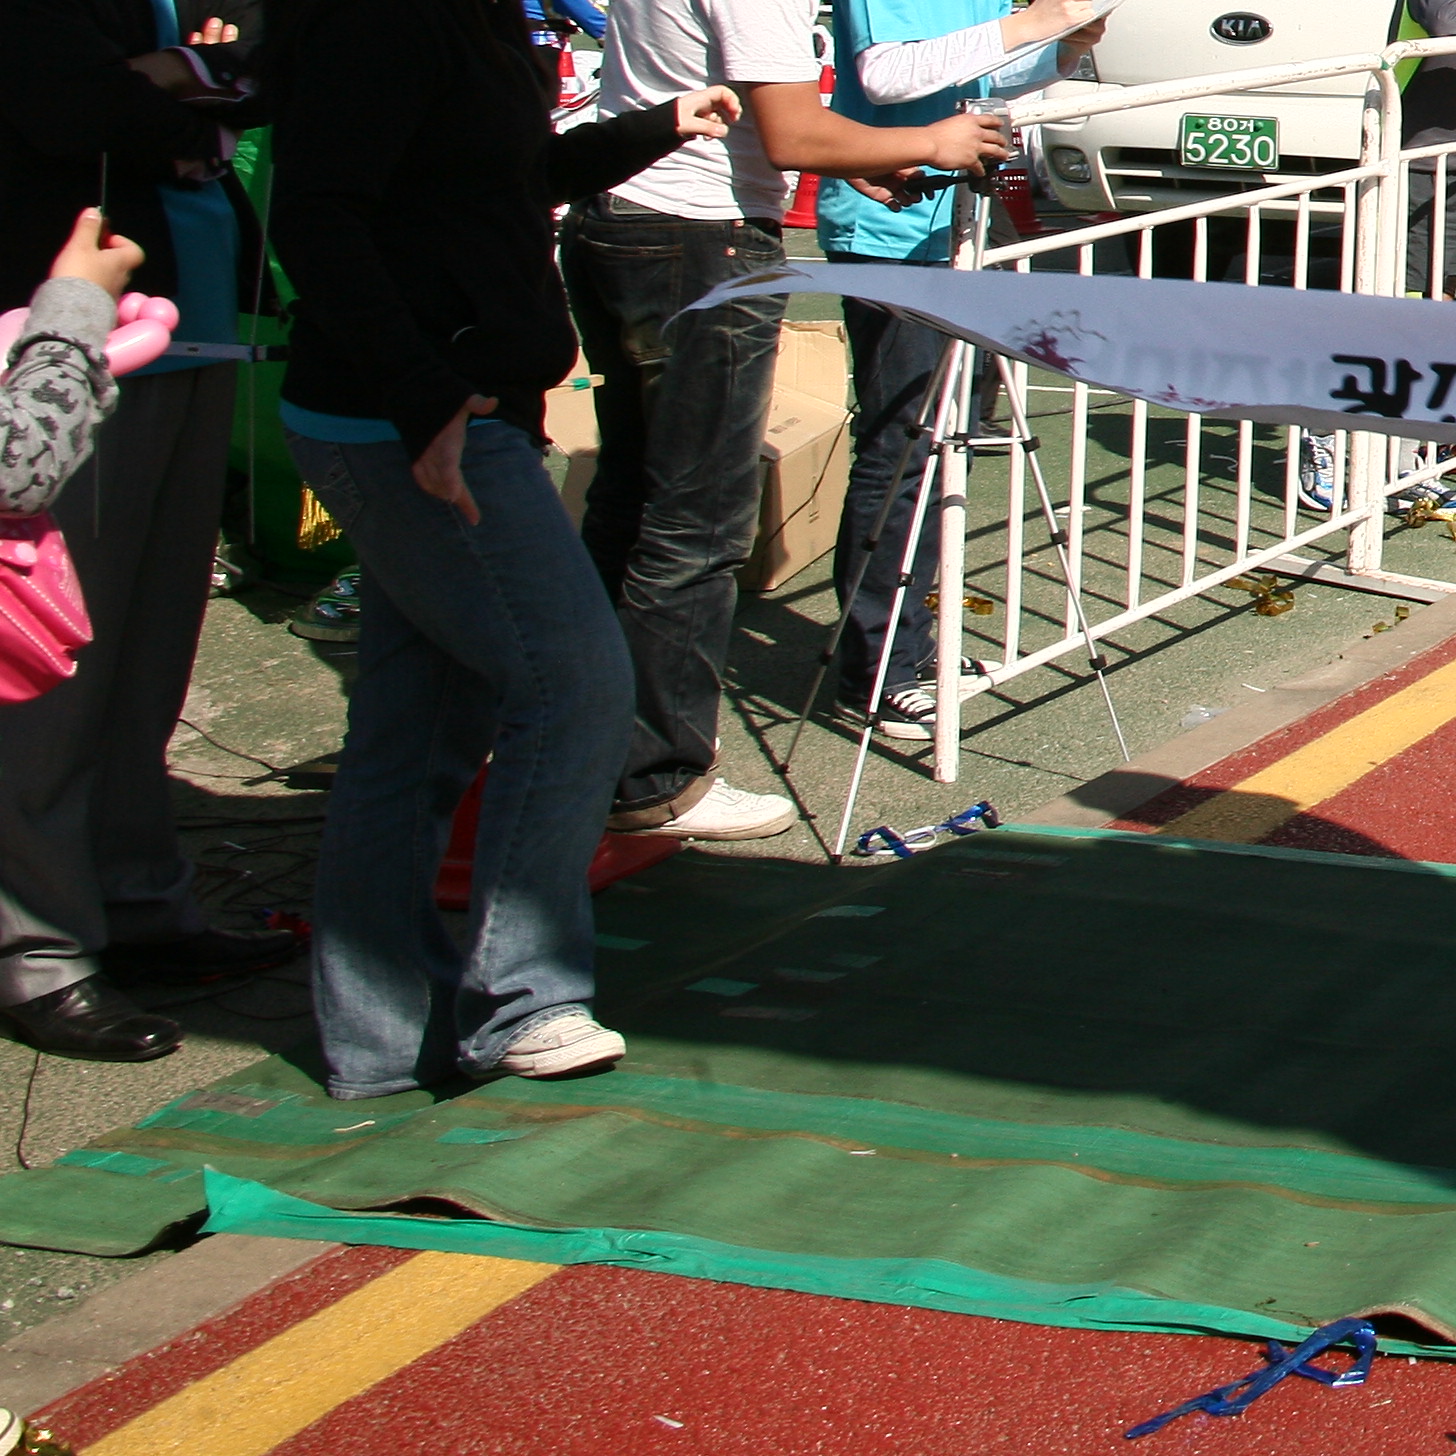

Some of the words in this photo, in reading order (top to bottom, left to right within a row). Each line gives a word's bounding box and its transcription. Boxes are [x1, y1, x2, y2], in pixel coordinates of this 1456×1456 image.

[1221, 18, 1262, 38] KIA
[1207, 117, 1255, 133] 80거
[1186, 132, 1275, 166] 5230
